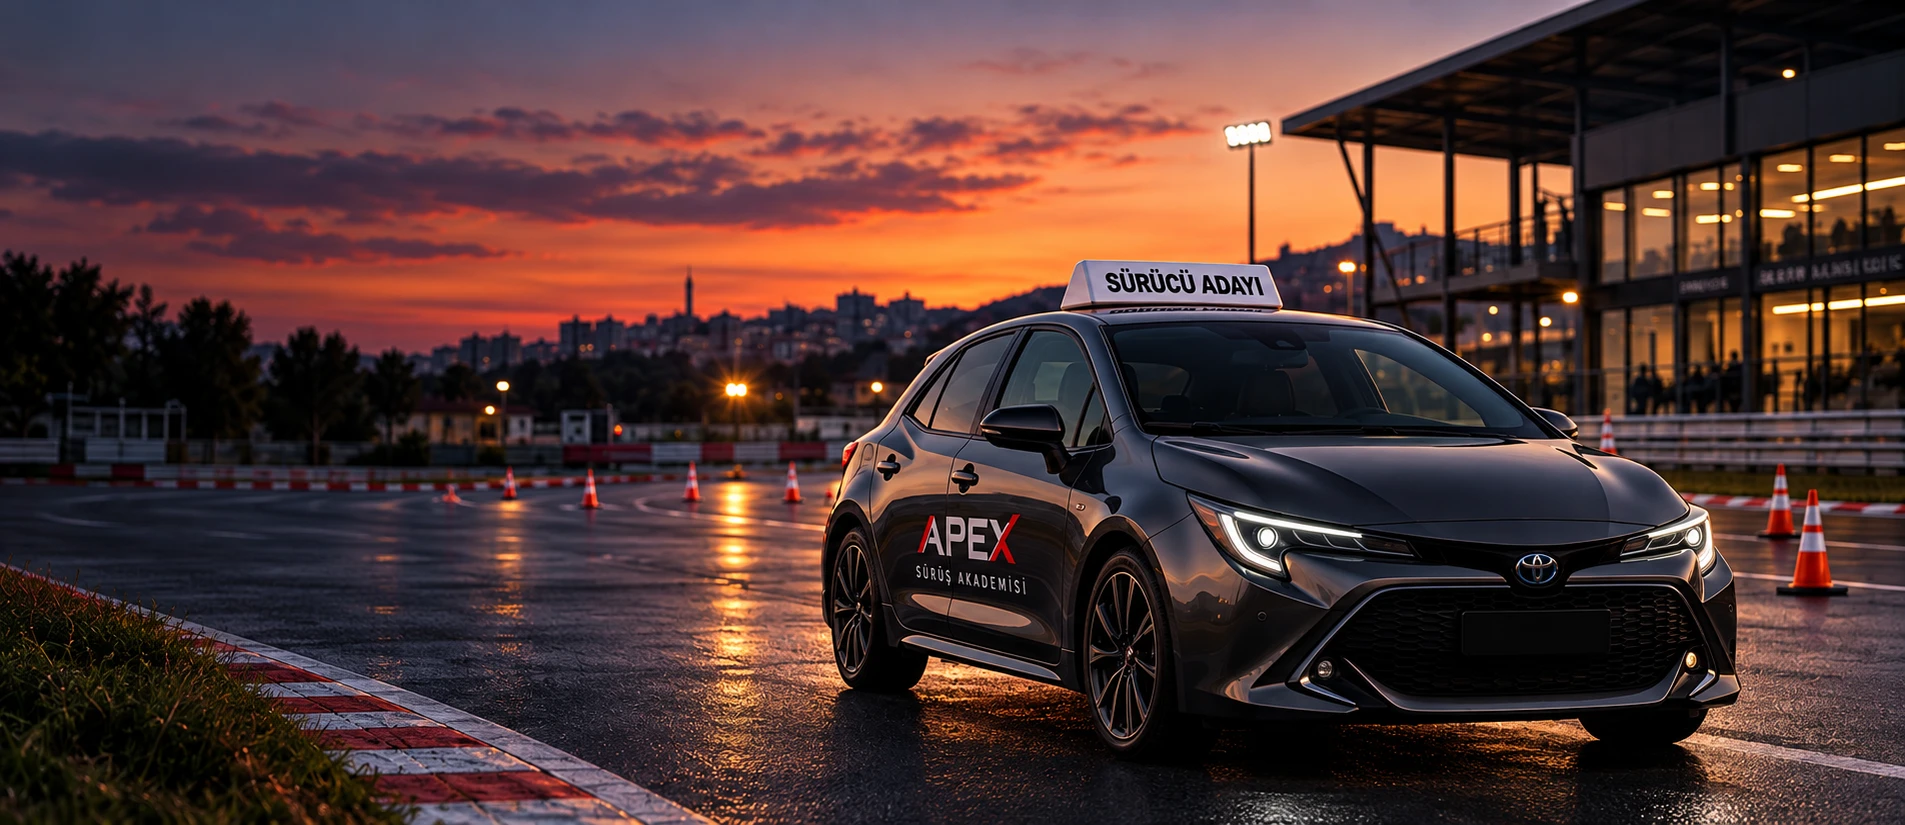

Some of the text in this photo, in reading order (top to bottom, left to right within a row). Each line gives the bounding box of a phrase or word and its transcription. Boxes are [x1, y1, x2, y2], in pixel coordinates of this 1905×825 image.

[1105, 268, 1264, 296] SÜRÜCÜ ADAYI
[917, 513, 1021, 564] APEX
[915, 563, 1027, 595] SÜRÜŞ AKADEMİSİ
